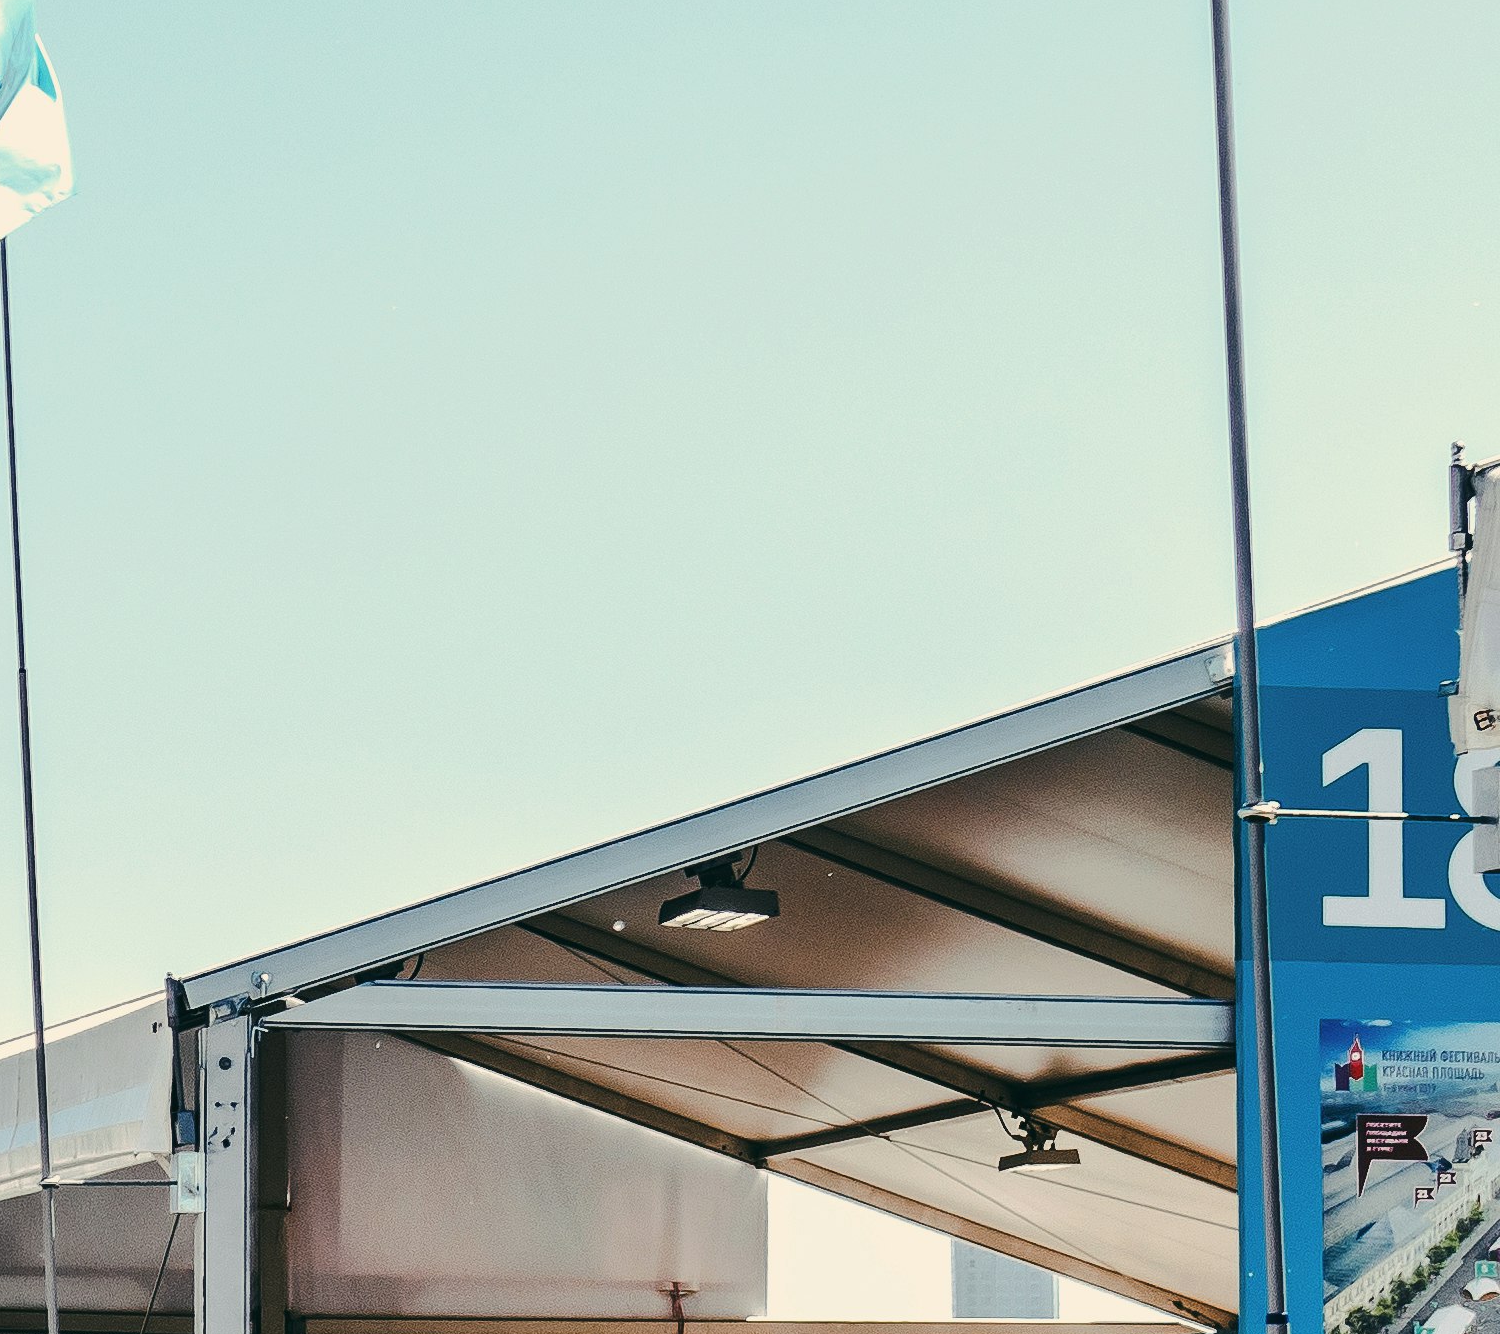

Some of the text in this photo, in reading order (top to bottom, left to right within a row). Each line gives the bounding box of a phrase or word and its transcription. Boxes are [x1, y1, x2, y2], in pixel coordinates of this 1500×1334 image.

[1381, 1049, 1437, 1062] КНИЖНЫЙ
[1382, 1066, 1485, 1080] КРАСНАЯ ПЛОЩАДЬ
